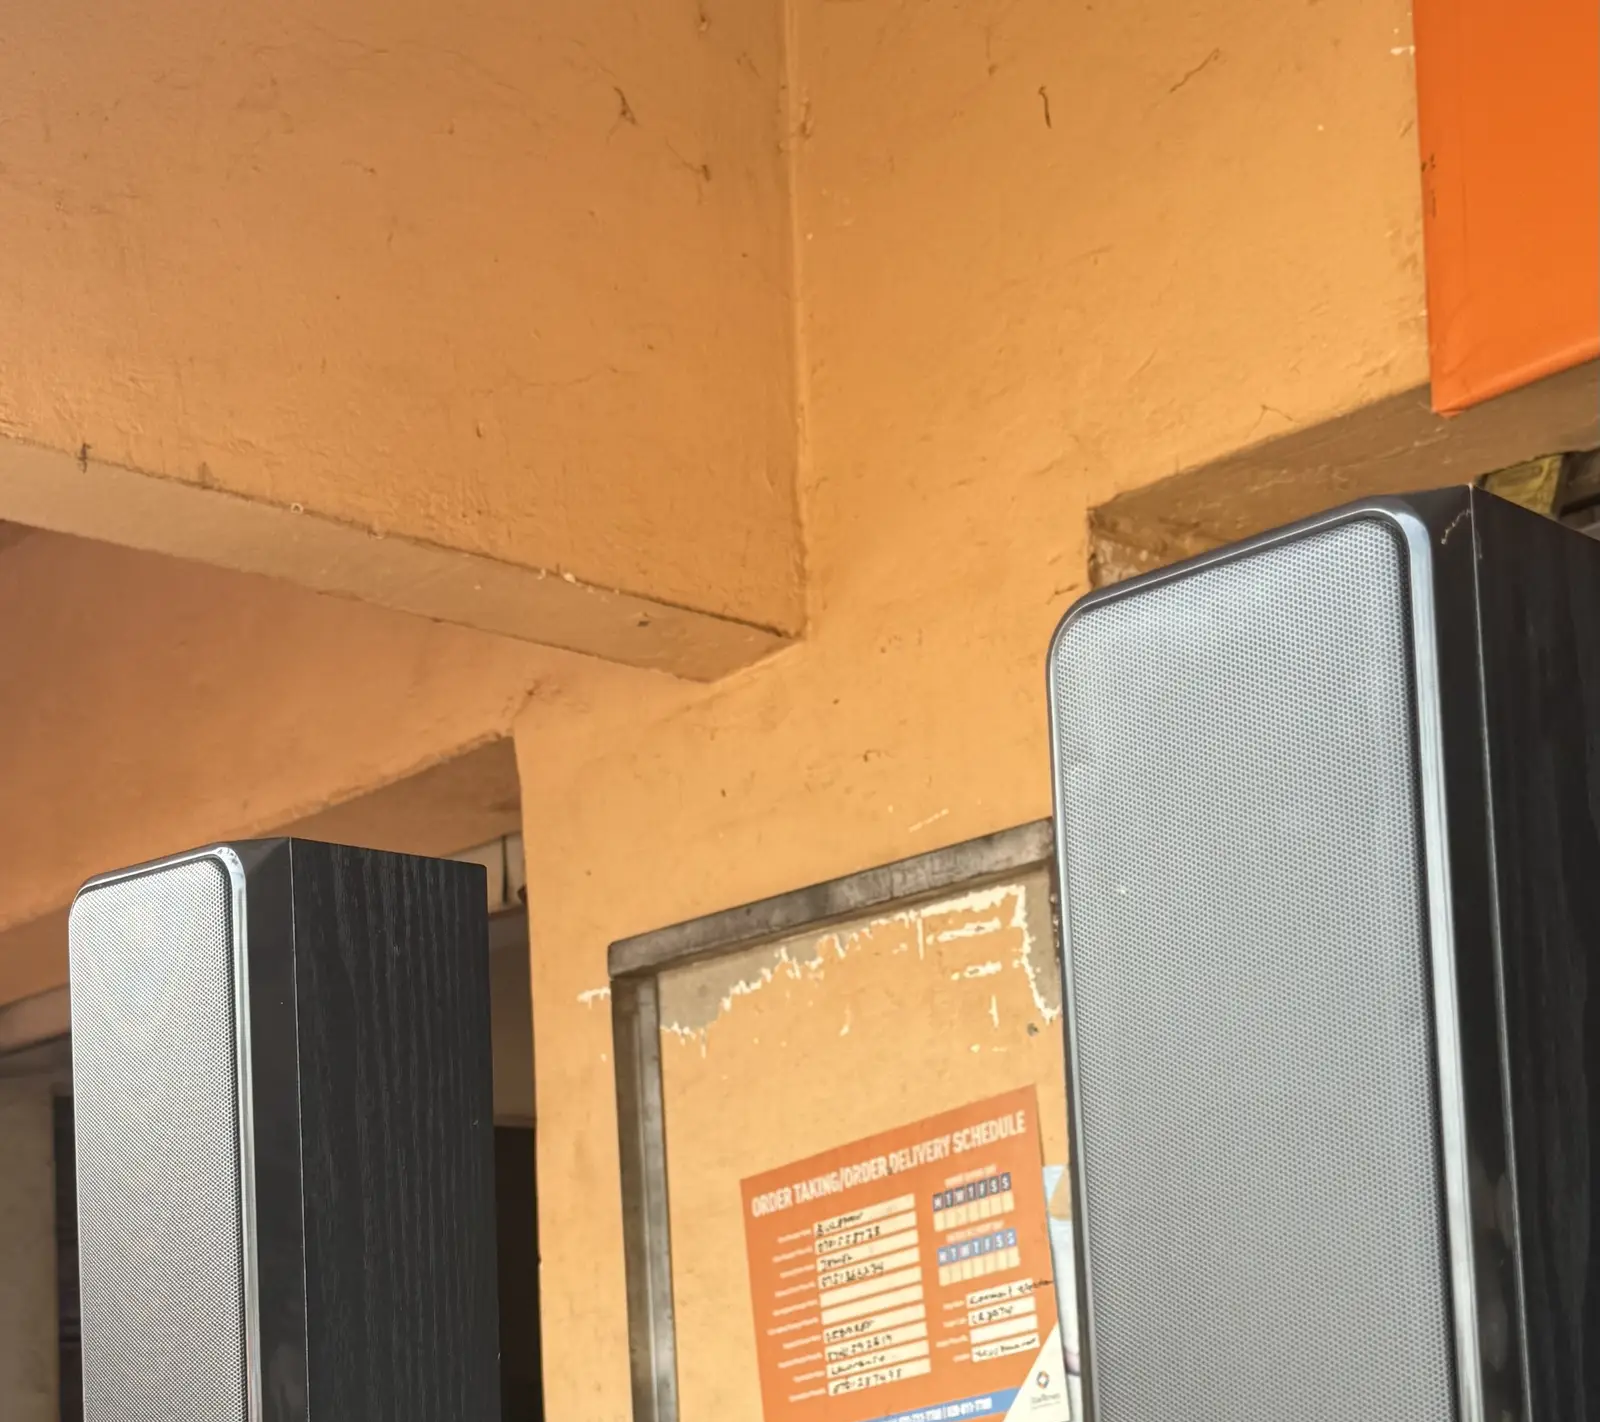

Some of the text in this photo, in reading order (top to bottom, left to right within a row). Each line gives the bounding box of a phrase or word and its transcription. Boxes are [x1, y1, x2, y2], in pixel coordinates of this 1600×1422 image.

[751, 1110, 1026, 1218] ORDER TAKING/ORDER DELIVERY SCHEDULE
